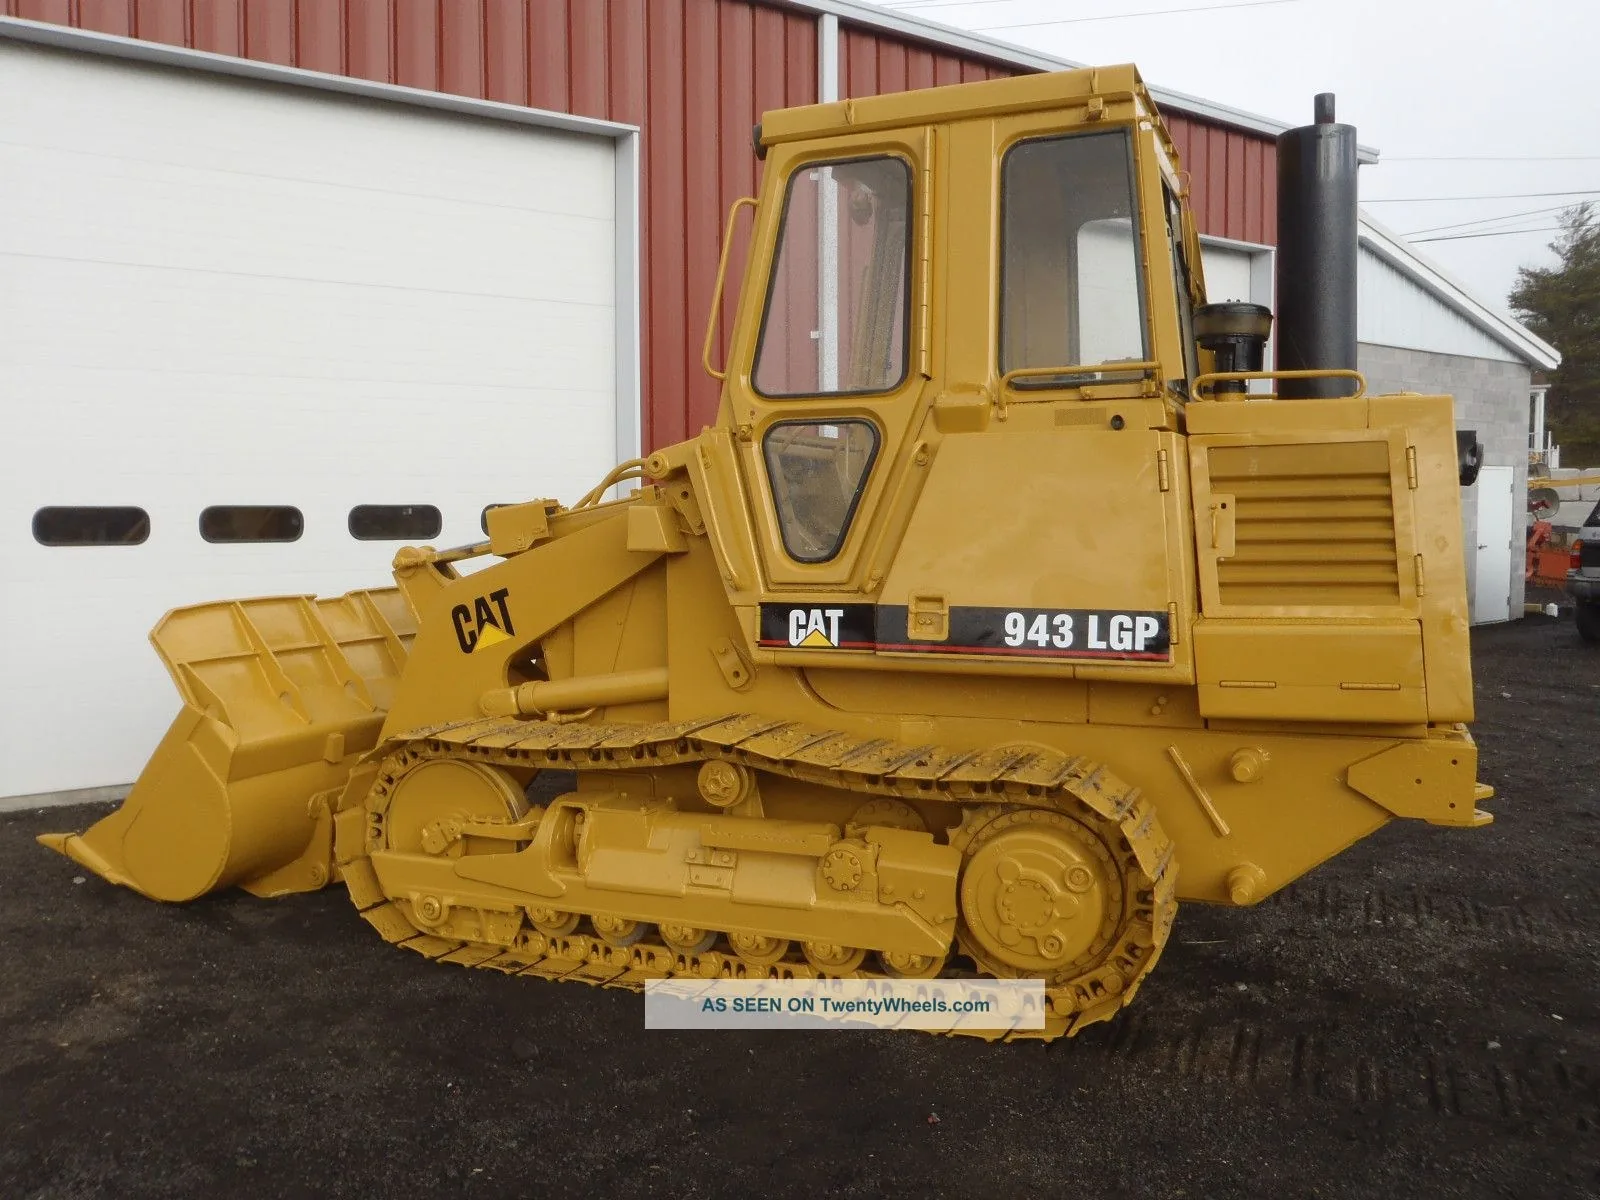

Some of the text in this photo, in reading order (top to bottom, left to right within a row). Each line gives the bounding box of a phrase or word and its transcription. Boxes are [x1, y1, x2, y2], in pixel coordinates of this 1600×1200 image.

[451, 587, 515, 654] CAT
[789, 609, 844, 647] CAT
[1004, 612, 1160, 651] 943 LGP
